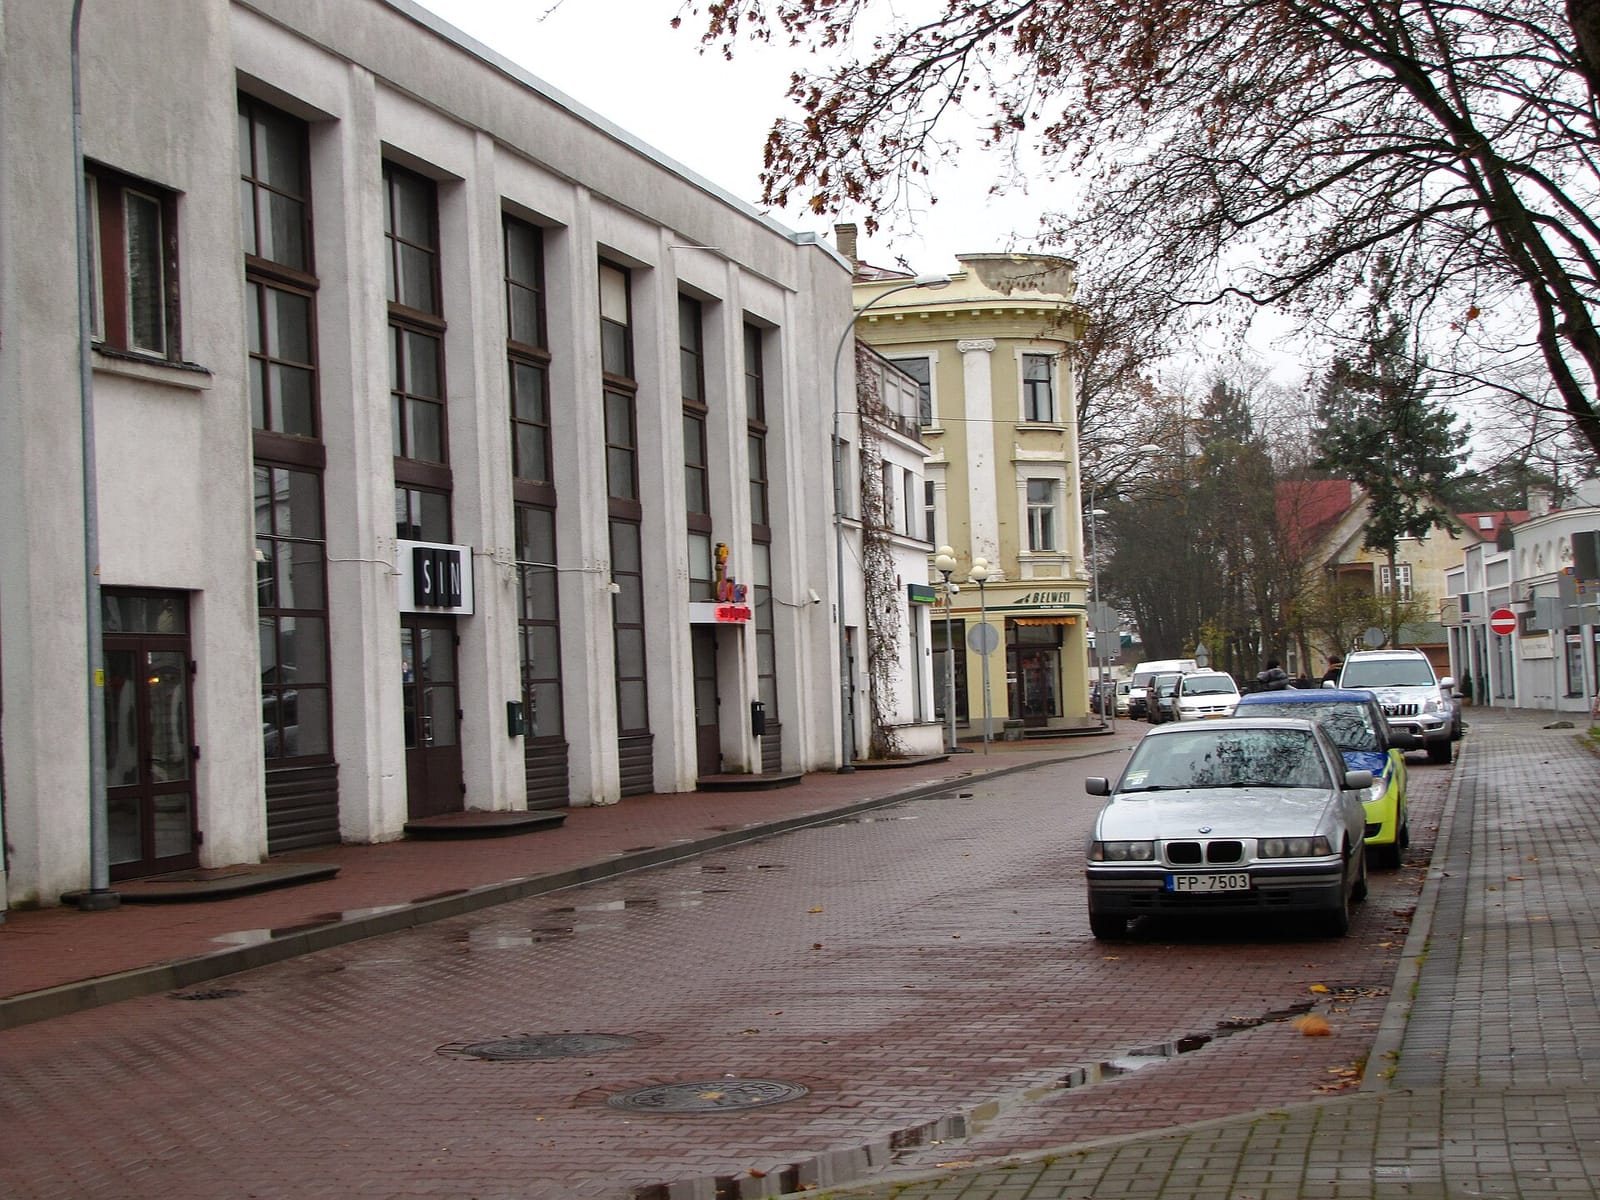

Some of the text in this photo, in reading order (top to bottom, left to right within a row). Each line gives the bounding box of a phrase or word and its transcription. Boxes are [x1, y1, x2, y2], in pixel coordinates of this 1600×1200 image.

[423, 559, 460, 595] SIN
[1033, 592, 1070, 603] BELWEST
[1176, 875, 1248, 890] FP-7503
